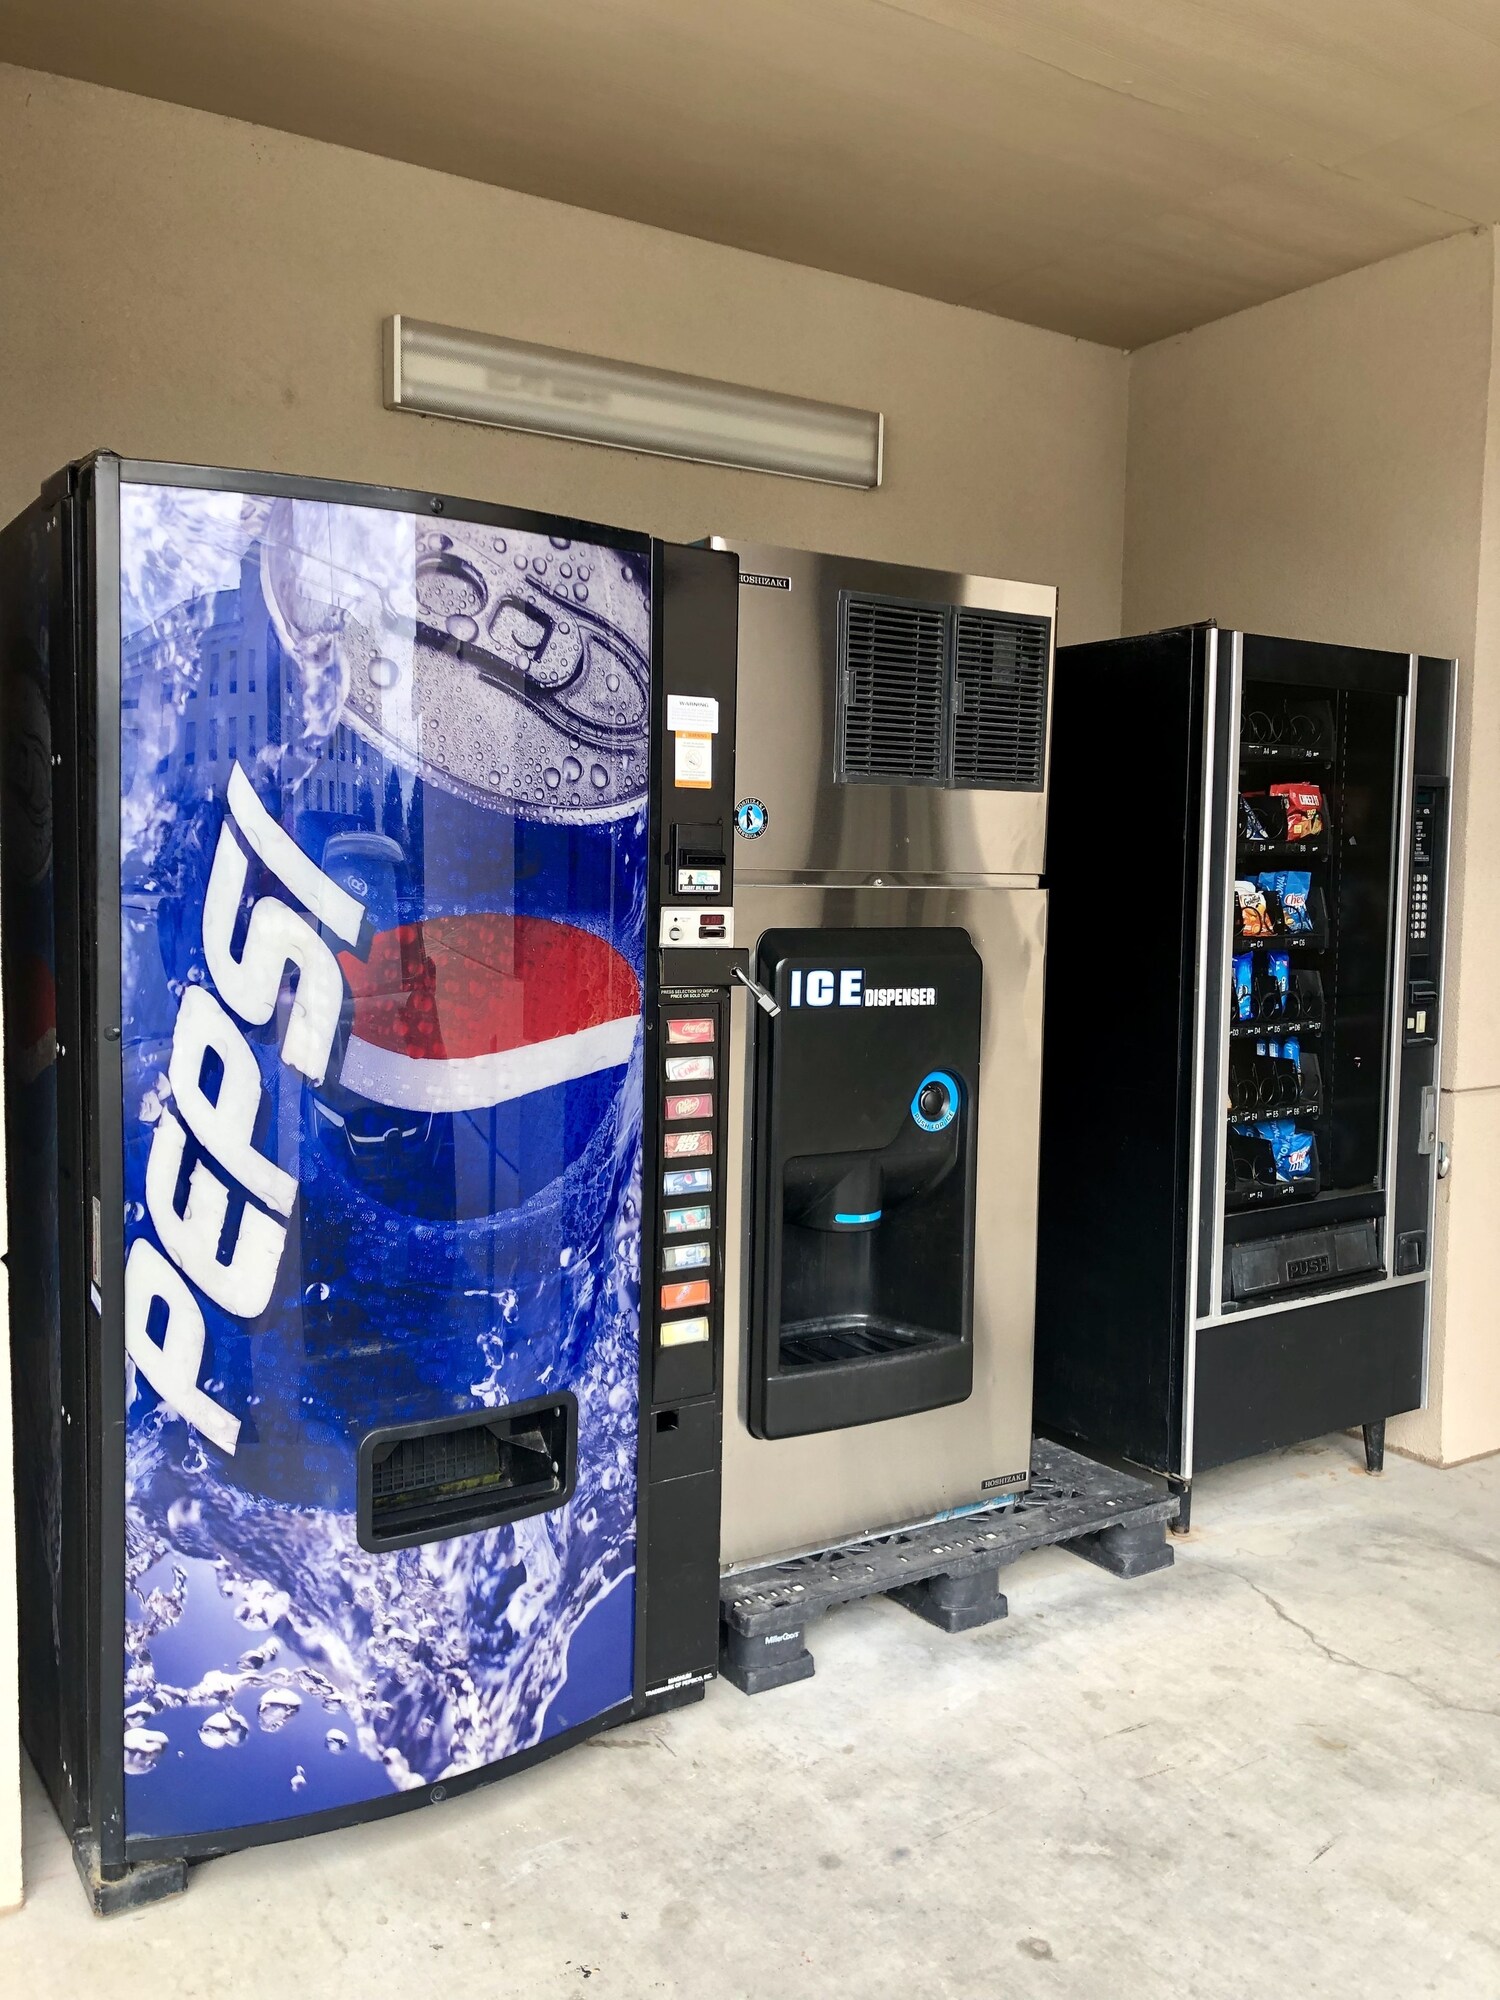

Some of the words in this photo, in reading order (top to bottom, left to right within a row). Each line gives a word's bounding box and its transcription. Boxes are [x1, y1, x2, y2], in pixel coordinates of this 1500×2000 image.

[679, 700, 709, 708] WARNING
[791, 969, 863, 1007] ICE
[864, 987, 937, 1007] DISPENSER
[677, 1061, 701, 1078] Coke
[125, 760, 366, 1457] PEPSI
[914, 1112, 929, 1129] PUSH
[944, 1111, 953, 1125] ICE
[677, 1133, 701, 1144] BIG
[674, 1142, 700, 1153] RED
[1289, 1258, 1329, 1278] PUSH
[984, 1473, 1025, 1488] HOSHIZAKI
